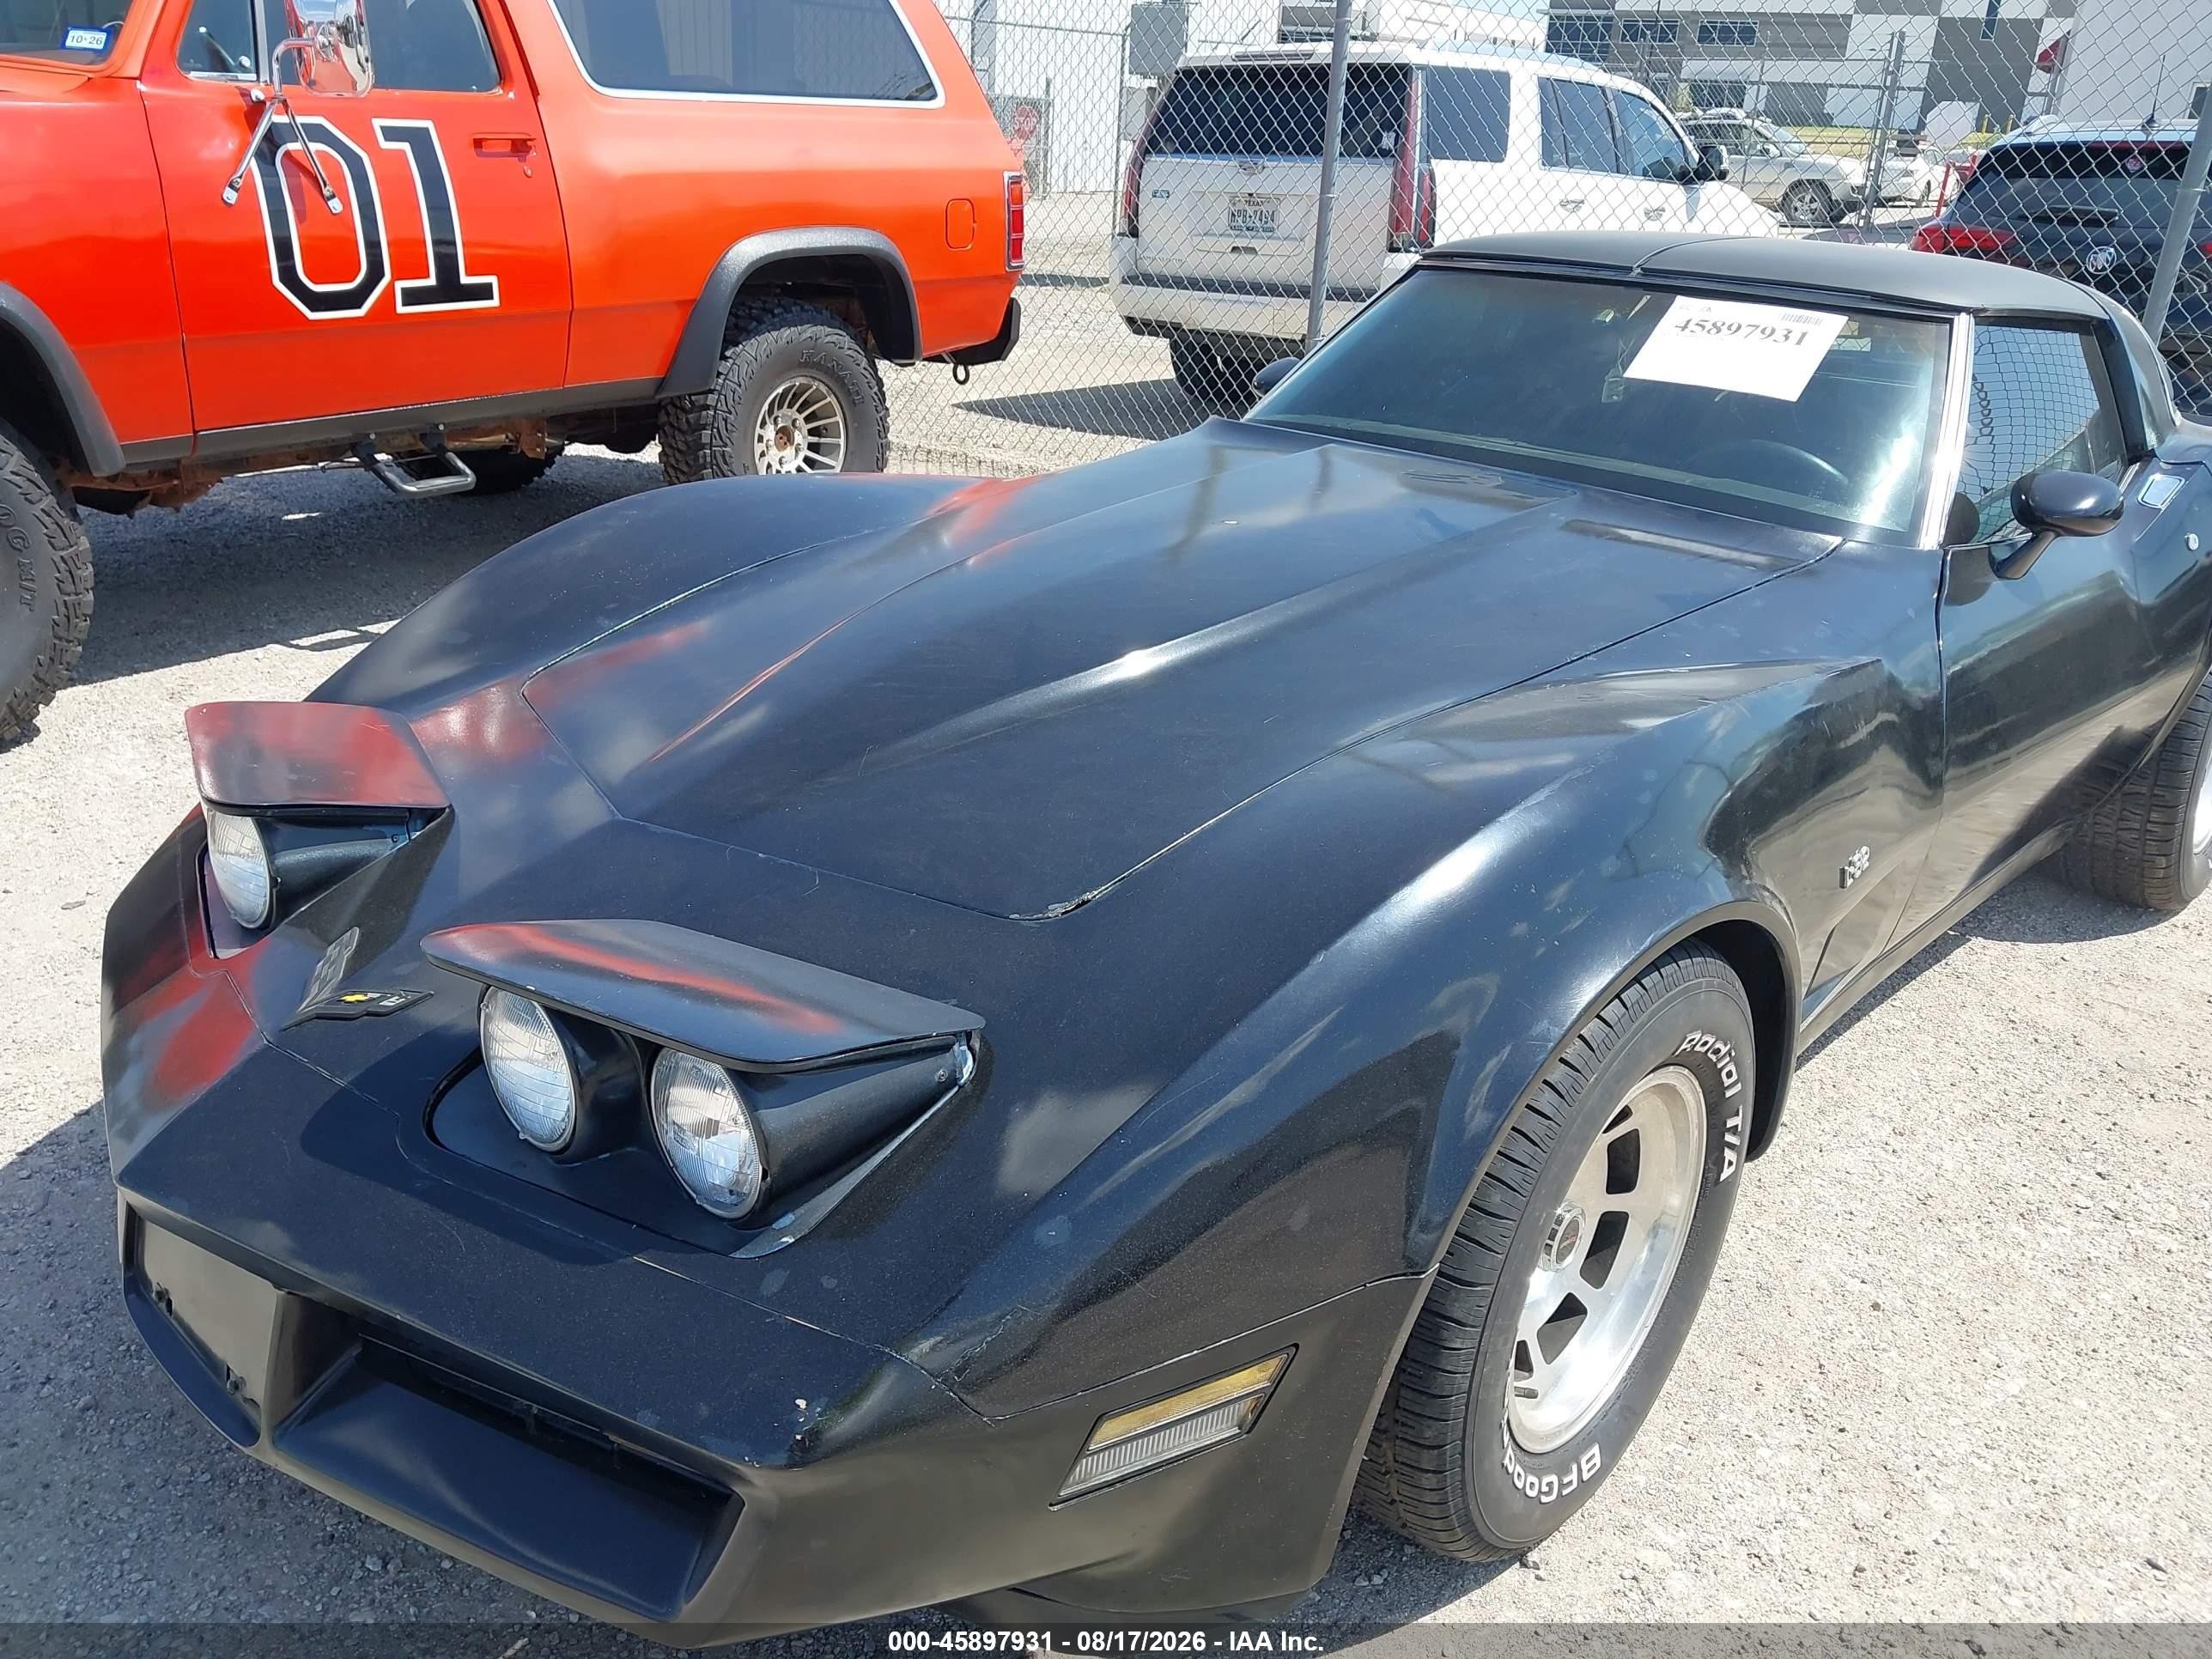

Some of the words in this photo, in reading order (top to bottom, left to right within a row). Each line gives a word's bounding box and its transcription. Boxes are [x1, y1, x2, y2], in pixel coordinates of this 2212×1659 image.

[1012, 116, 1037, 131] STOP
[249, 114, 501, 321] 01
[1674, 318, 1809, 346] 45897931
[1674, 1030, 1743, 1099] Radial
[1719, 1104, 1744, 1182] T/A
